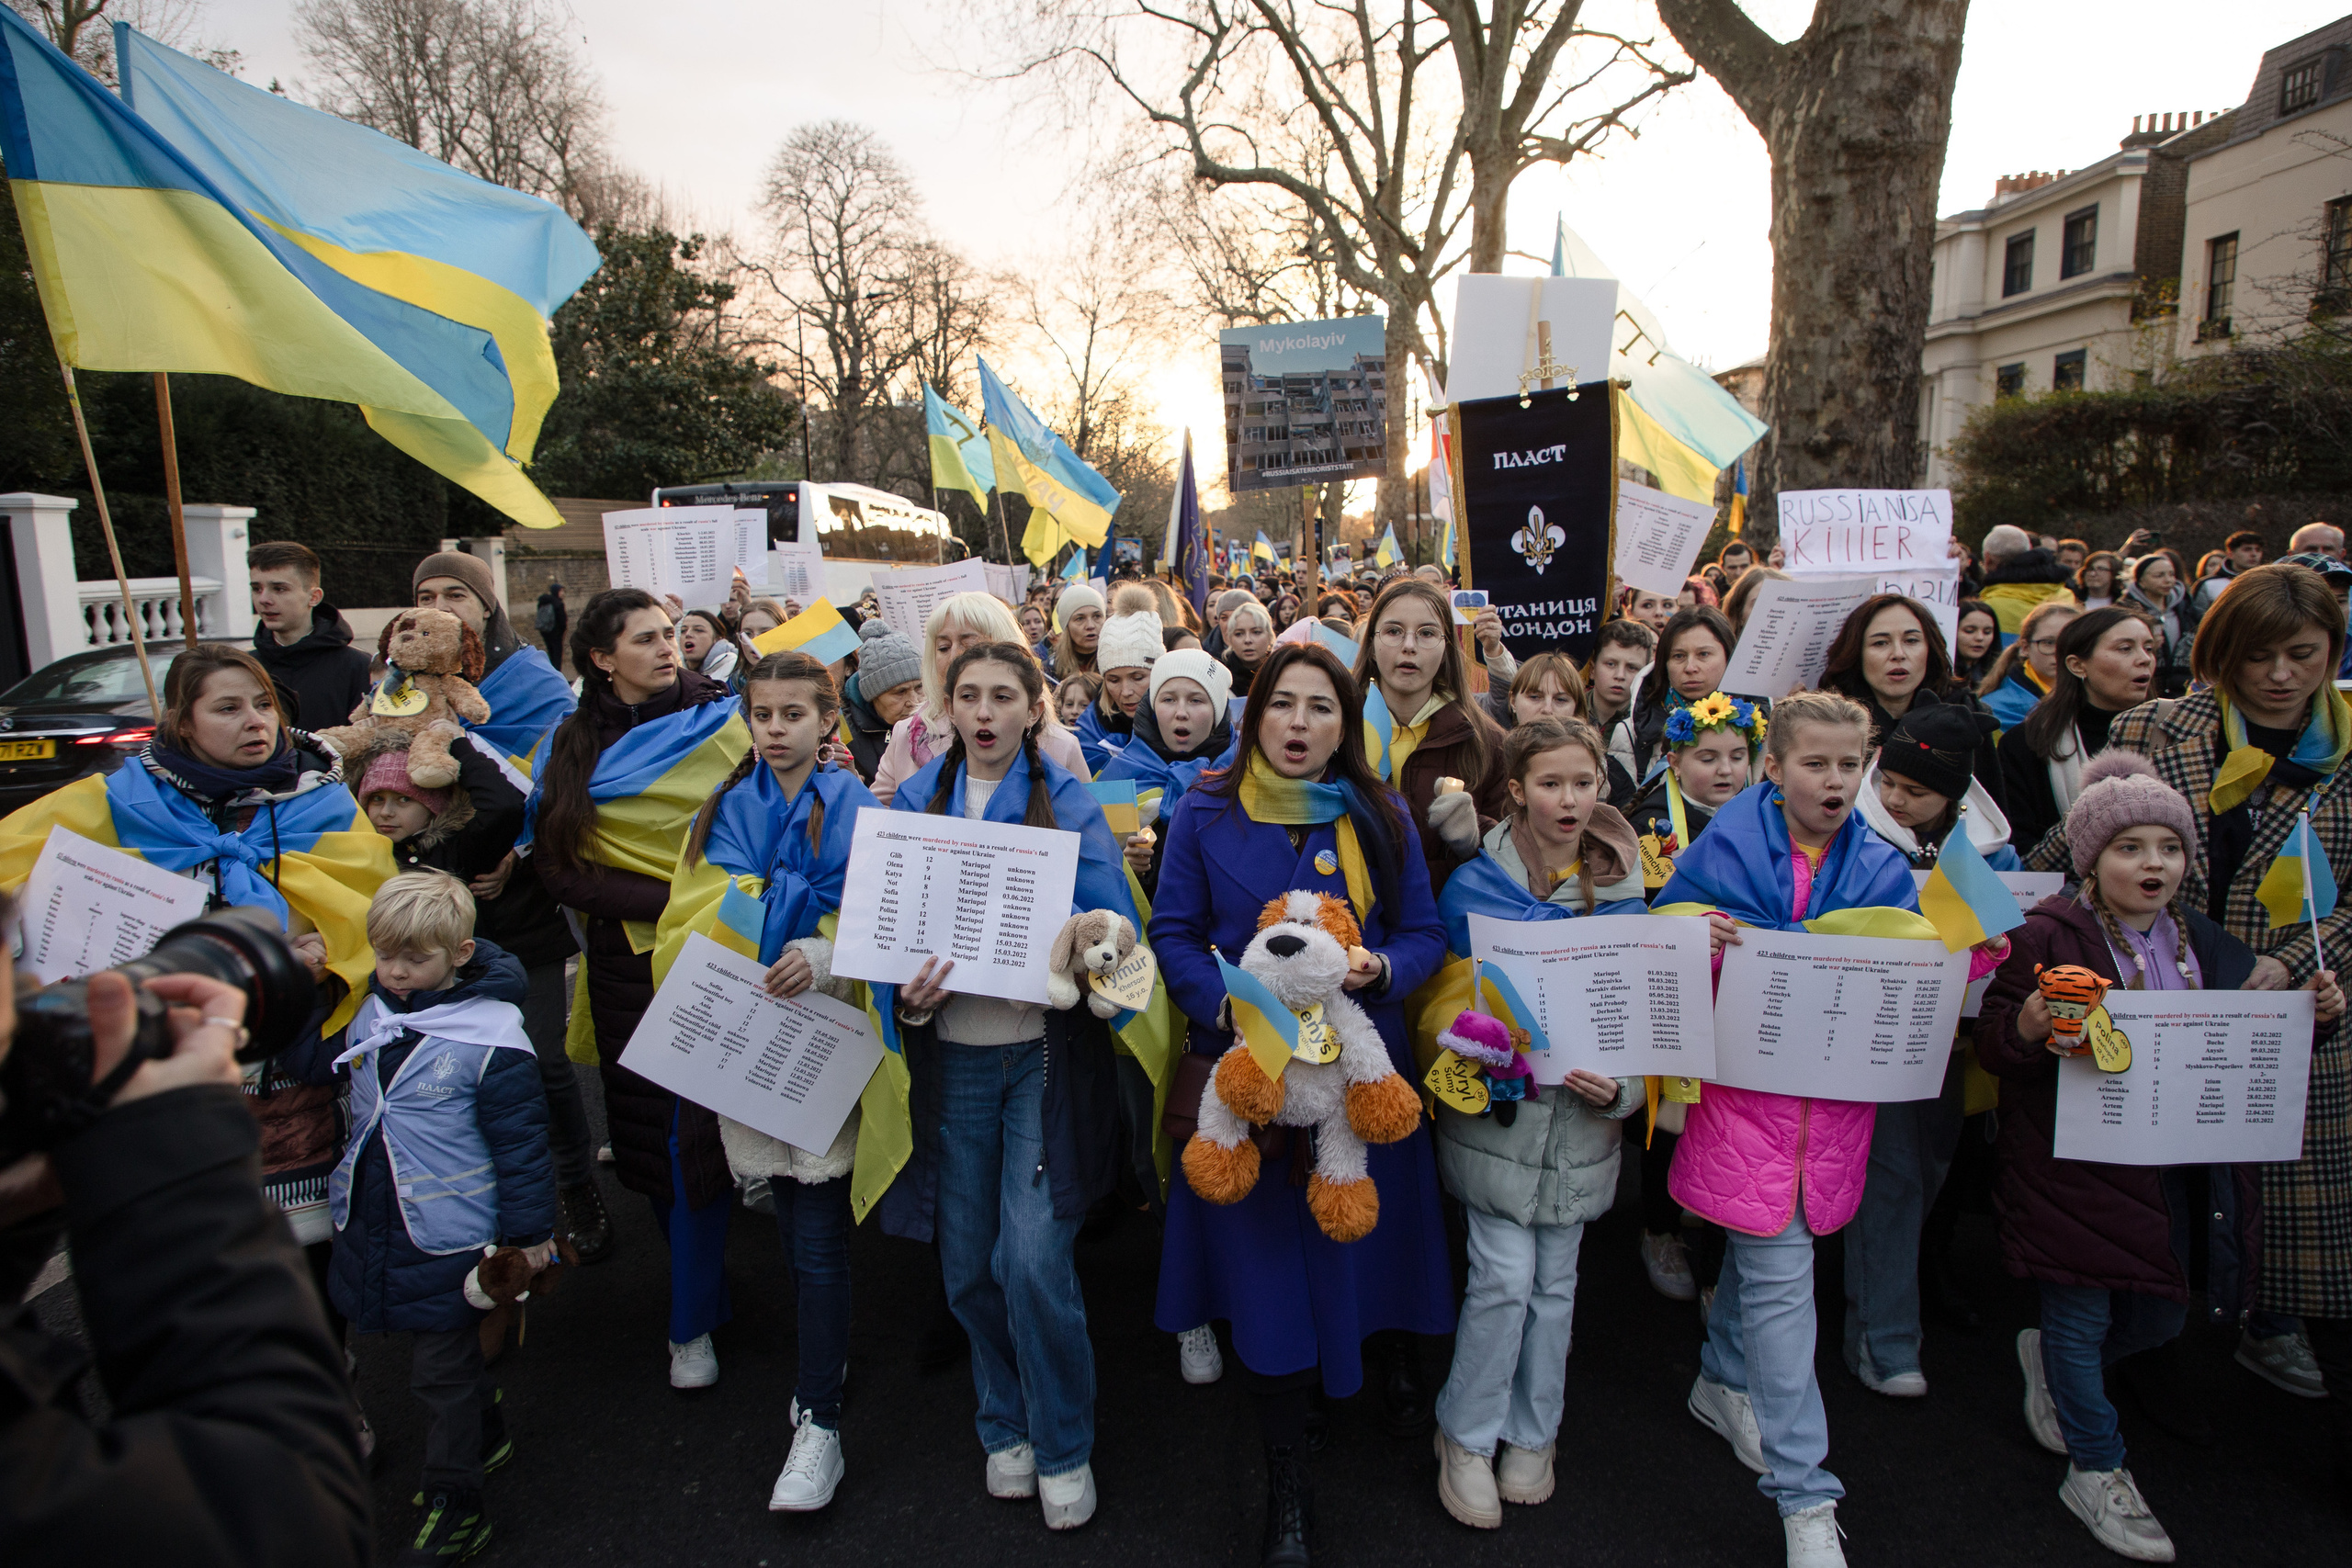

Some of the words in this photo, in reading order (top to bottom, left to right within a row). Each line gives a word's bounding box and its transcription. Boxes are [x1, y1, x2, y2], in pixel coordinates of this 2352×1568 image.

[1260, 333, 1346, 355] Mykolayiv
[1493, 445, 1566, 469] ПЛАСТ
[1261, 463, 1354, 477] #RUSSIAISATERRORISTSTATE
[695, 492, 763, 504] Mercedes-Benz
[1495, 597, 1597, 619] ТАНИЦЯ
[395, 686, 412, 707] ana
[886, 831, 908, 840] children
[1015, 847, 1038, 855] russia's
[950, 848, 970, 856] against
[972, 851, 996, 859] Ukraine
[1639, 840, 1667, 880] Artemchyk
[961, 861, 991, 870] Mariupol
[1007, 867, 1036, 875] unknown
[960, 870, 989, 879] Mariupol
[1006, 876, 1035, 885] unknown
[957, 887, 988, 897] Mariupol
[959, 878, 989, 888] Mariupol
[1005, 886, 1034, 894] unknown
[957, 897, 987, 906] Mariupol
[1002, 904, 1032, 912] unknown
[956, 906, 986, 915] Mariupol
[1001, 913, 1030, 921] unknown
[955, 915, 984, 924] Mariupol
[1000, 921, 1029, 931] unknown
[953, 933, 981, 942] Mariupol
[954, 924, 983, 933] Mariupol
[999, 931, 1028, 940] unknown
[952, 942, 979, 953] Mariupol
[1501, 947, 1523, 955] children
[1541, 947, 1570, 956] murdered
[950, 952, 978, 961] Mariupol
[1571, 953, 1592, 961] against
[1095, 955, 1148, 989] Tymur
[1118, 976, 1146, 993] Kherson
[786, 997, 803, 1009] russia
[813, 1010, 829, 1021] result
[854, 1028, 865, 1037] full
[794, 1008, 815, 1022] Ukraine
[2184, 1012, 2190, 1021] by
[1300, 1010, 1331, 1055] enys
[673, 1035, 695, 1049] Maksym
[1444, 1066, 1455, 1094] Sumy
[1453, 1059, 1476, 1102] Kyryl
[417, 1081, 456, 1095] ПЛАСТ
